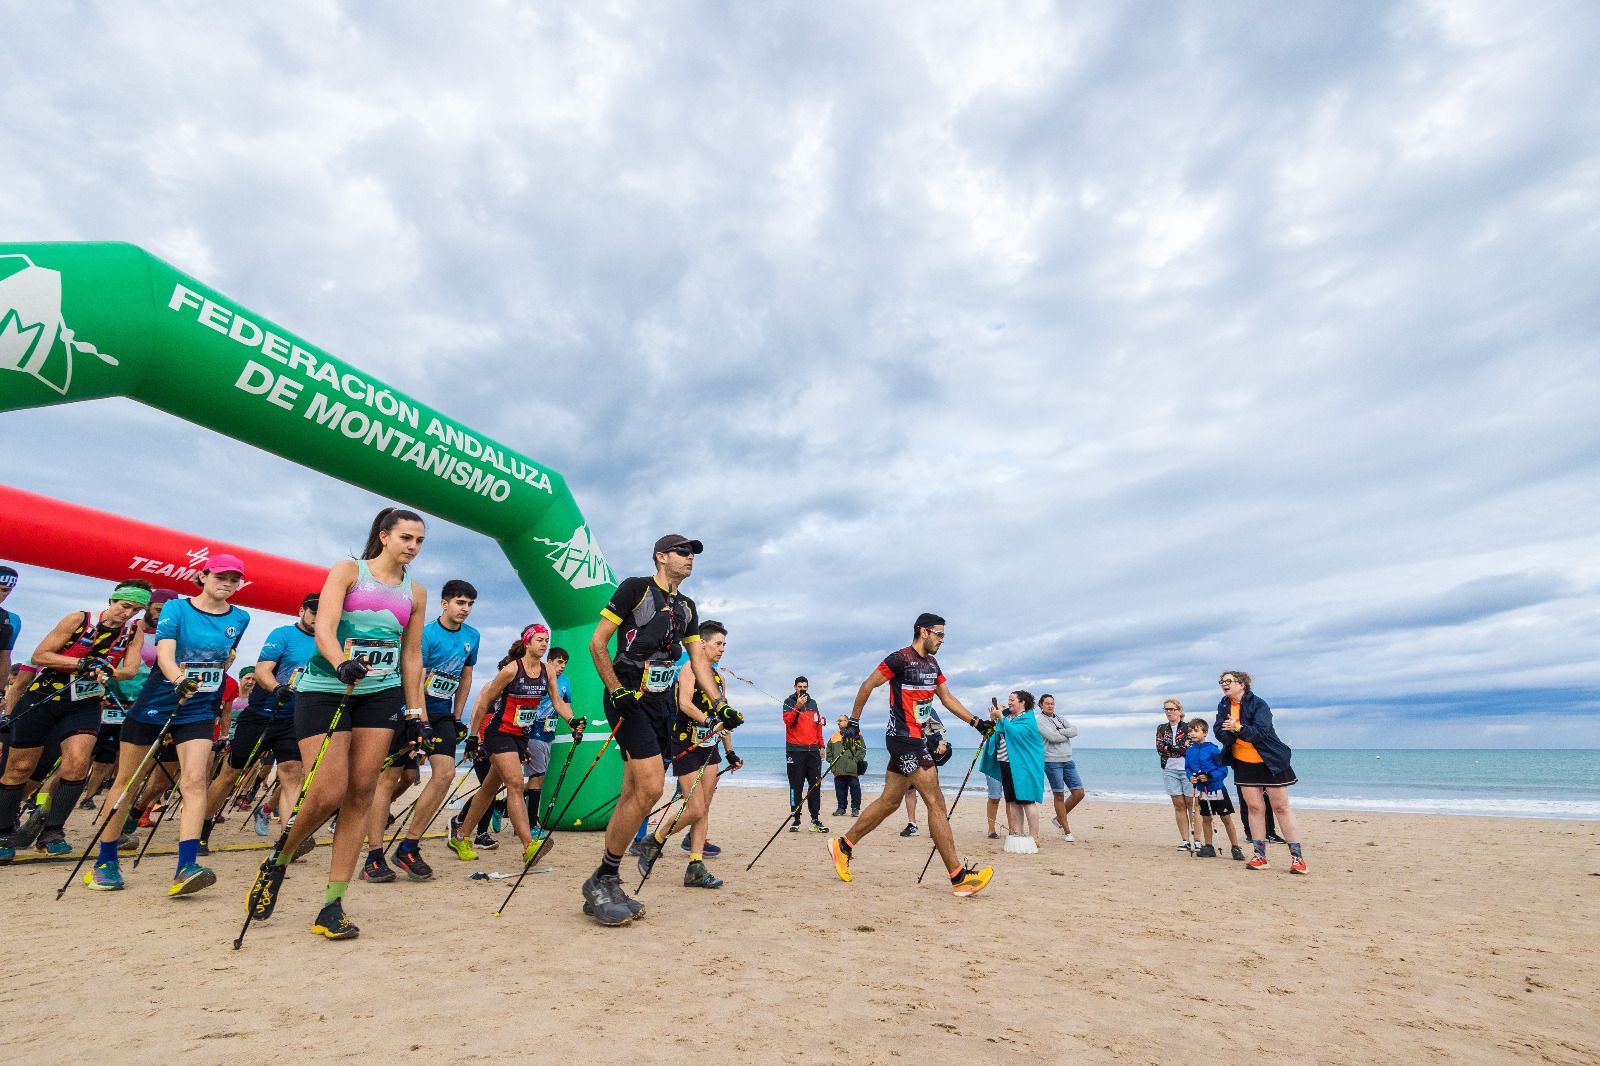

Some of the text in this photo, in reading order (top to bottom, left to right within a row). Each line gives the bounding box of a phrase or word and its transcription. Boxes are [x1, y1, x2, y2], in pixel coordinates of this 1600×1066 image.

[168, 283, 553, 494] FEDERACIÓN ANDALUZA
[234, 359, 511, 502] DE MONTAÑISMO
[75, 682, 99, 693] 512
[432, 679, 457, 692] 507
